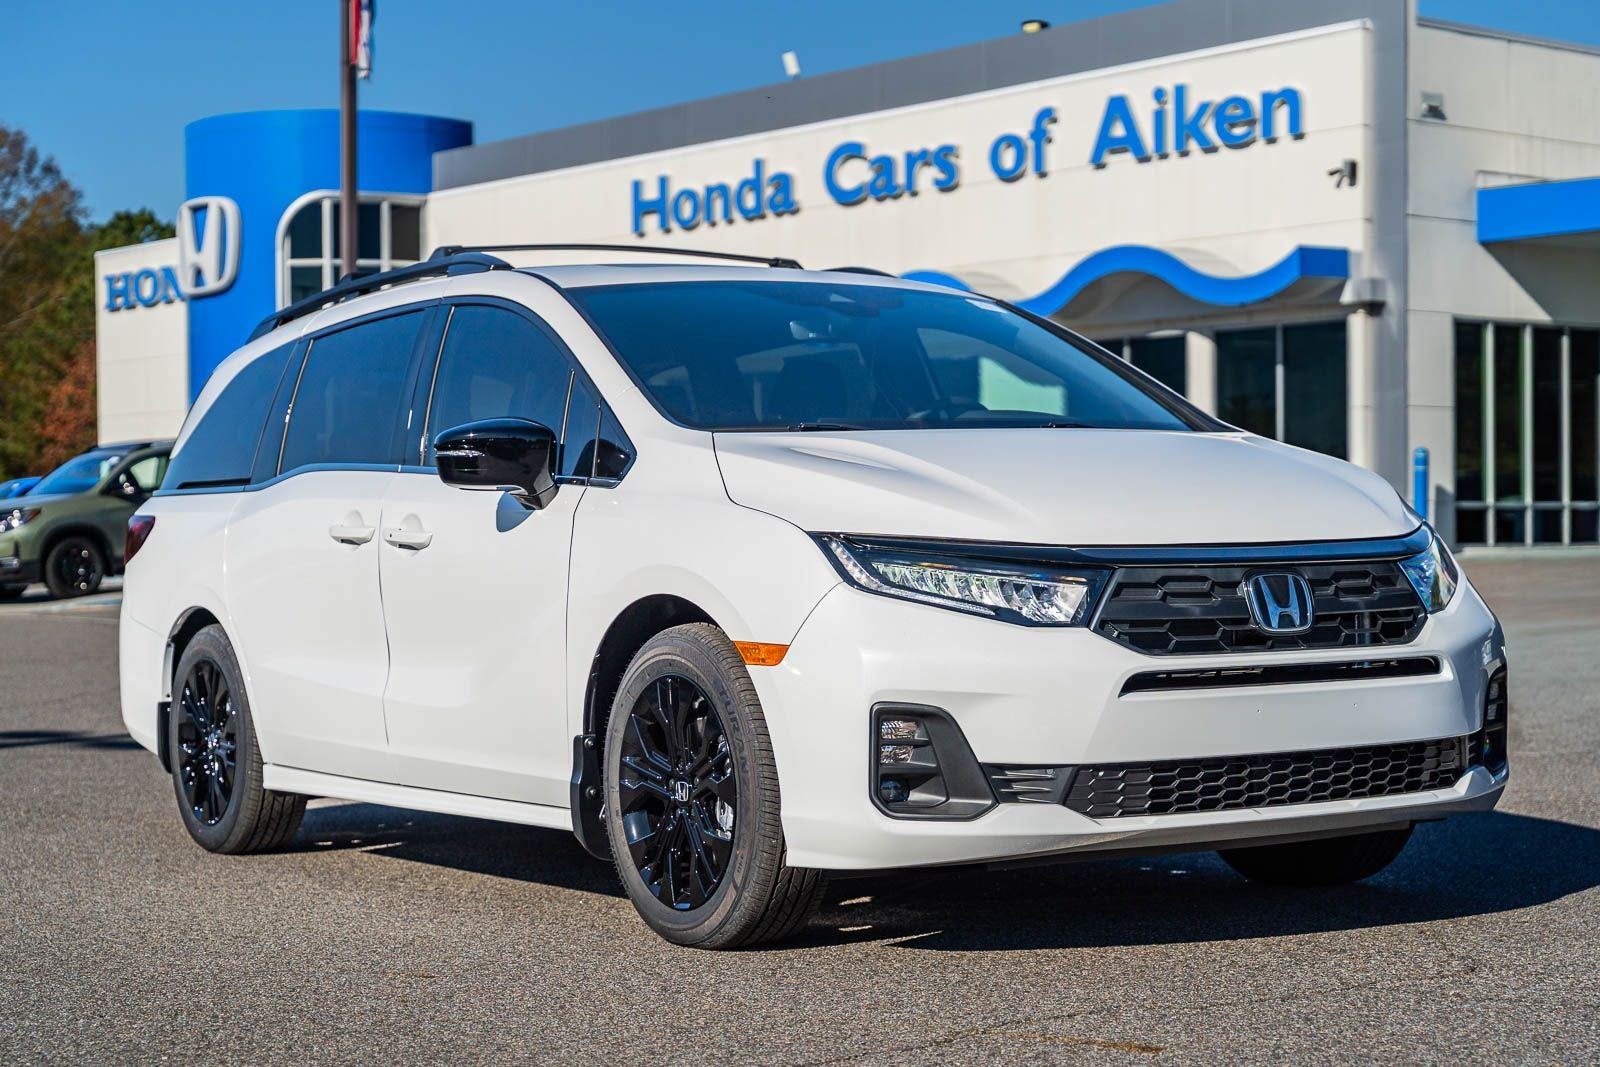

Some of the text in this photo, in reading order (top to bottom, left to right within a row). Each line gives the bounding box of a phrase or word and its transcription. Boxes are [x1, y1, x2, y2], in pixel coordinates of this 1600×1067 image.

[632, 83, 1304, 237] Honda Cars of Aiken
